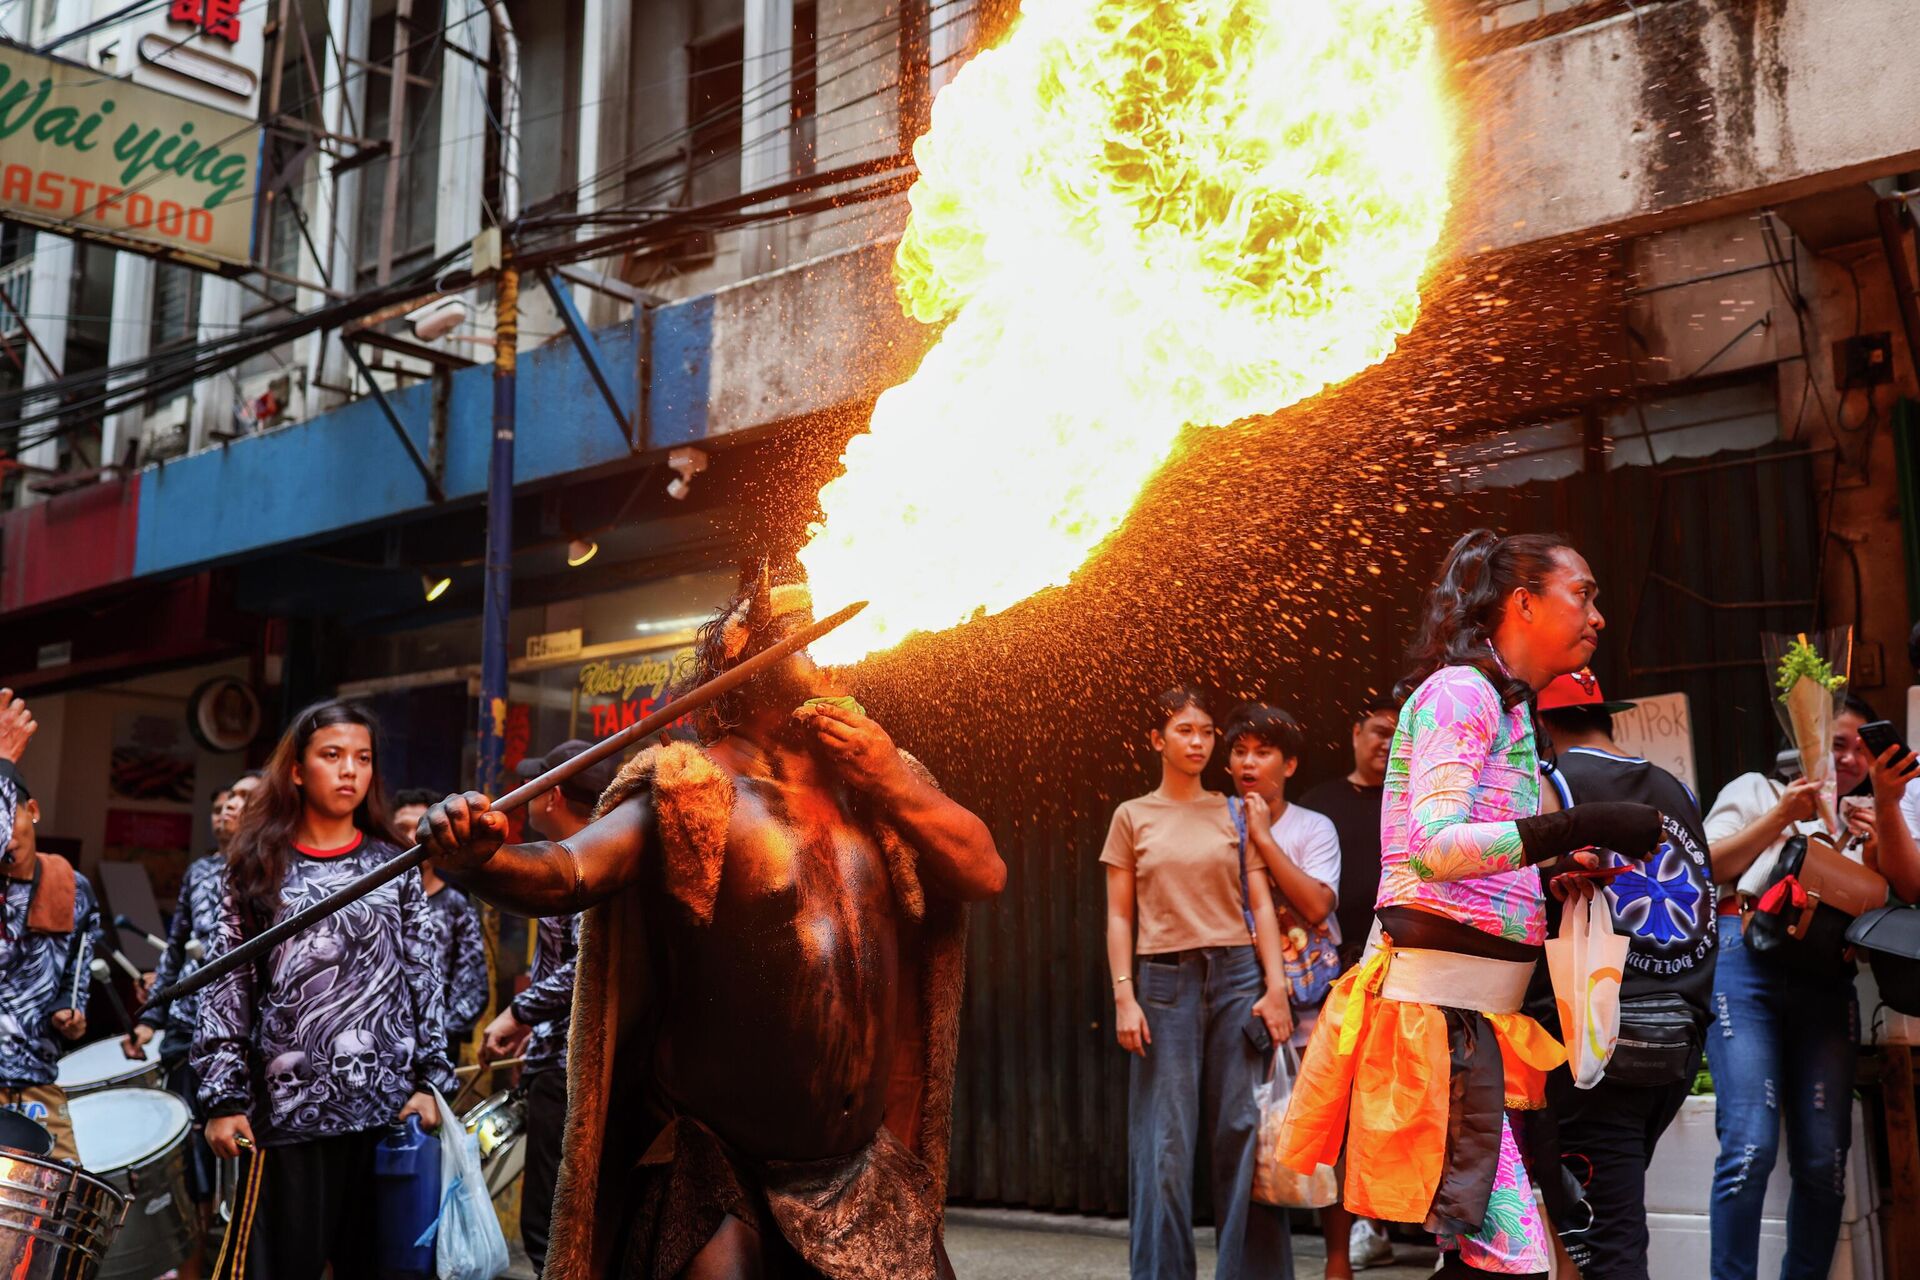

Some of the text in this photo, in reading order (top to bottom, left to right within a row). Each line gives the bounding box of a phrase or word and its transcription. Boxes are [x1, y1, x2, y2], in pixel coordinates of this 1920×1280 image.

[0, 160, 213, 244] ASTFOOD
[113, 122, 246, 209] ying
[1626, 948, 1695, 975] HOLLYW
